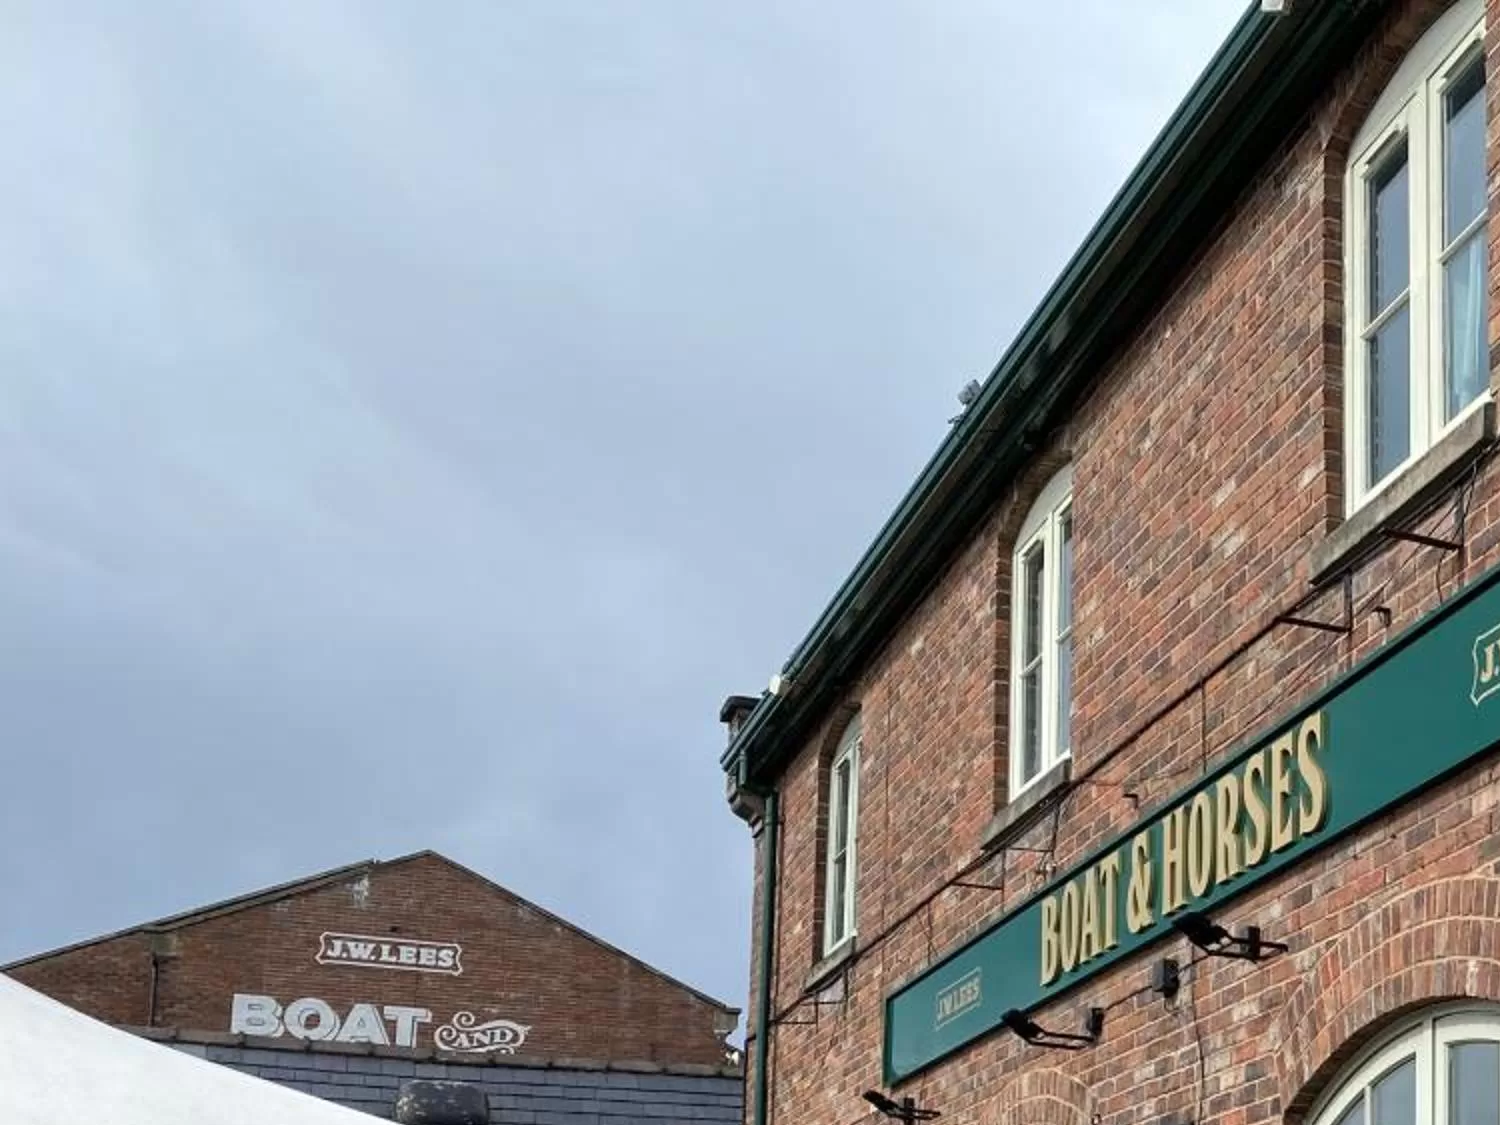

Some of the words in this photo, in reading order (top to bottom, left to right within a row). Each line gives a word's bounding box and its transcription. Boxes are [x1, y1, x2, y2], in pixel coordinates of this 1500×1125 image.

[1040, 851, 1121, 987] BOAT
[1127, 832, 1155, 934] &
[1162, 710, 1328, 915] HORSES
[231, 993, 432, 1048] BOAT
[452, 1028, 513, 1048] AND
